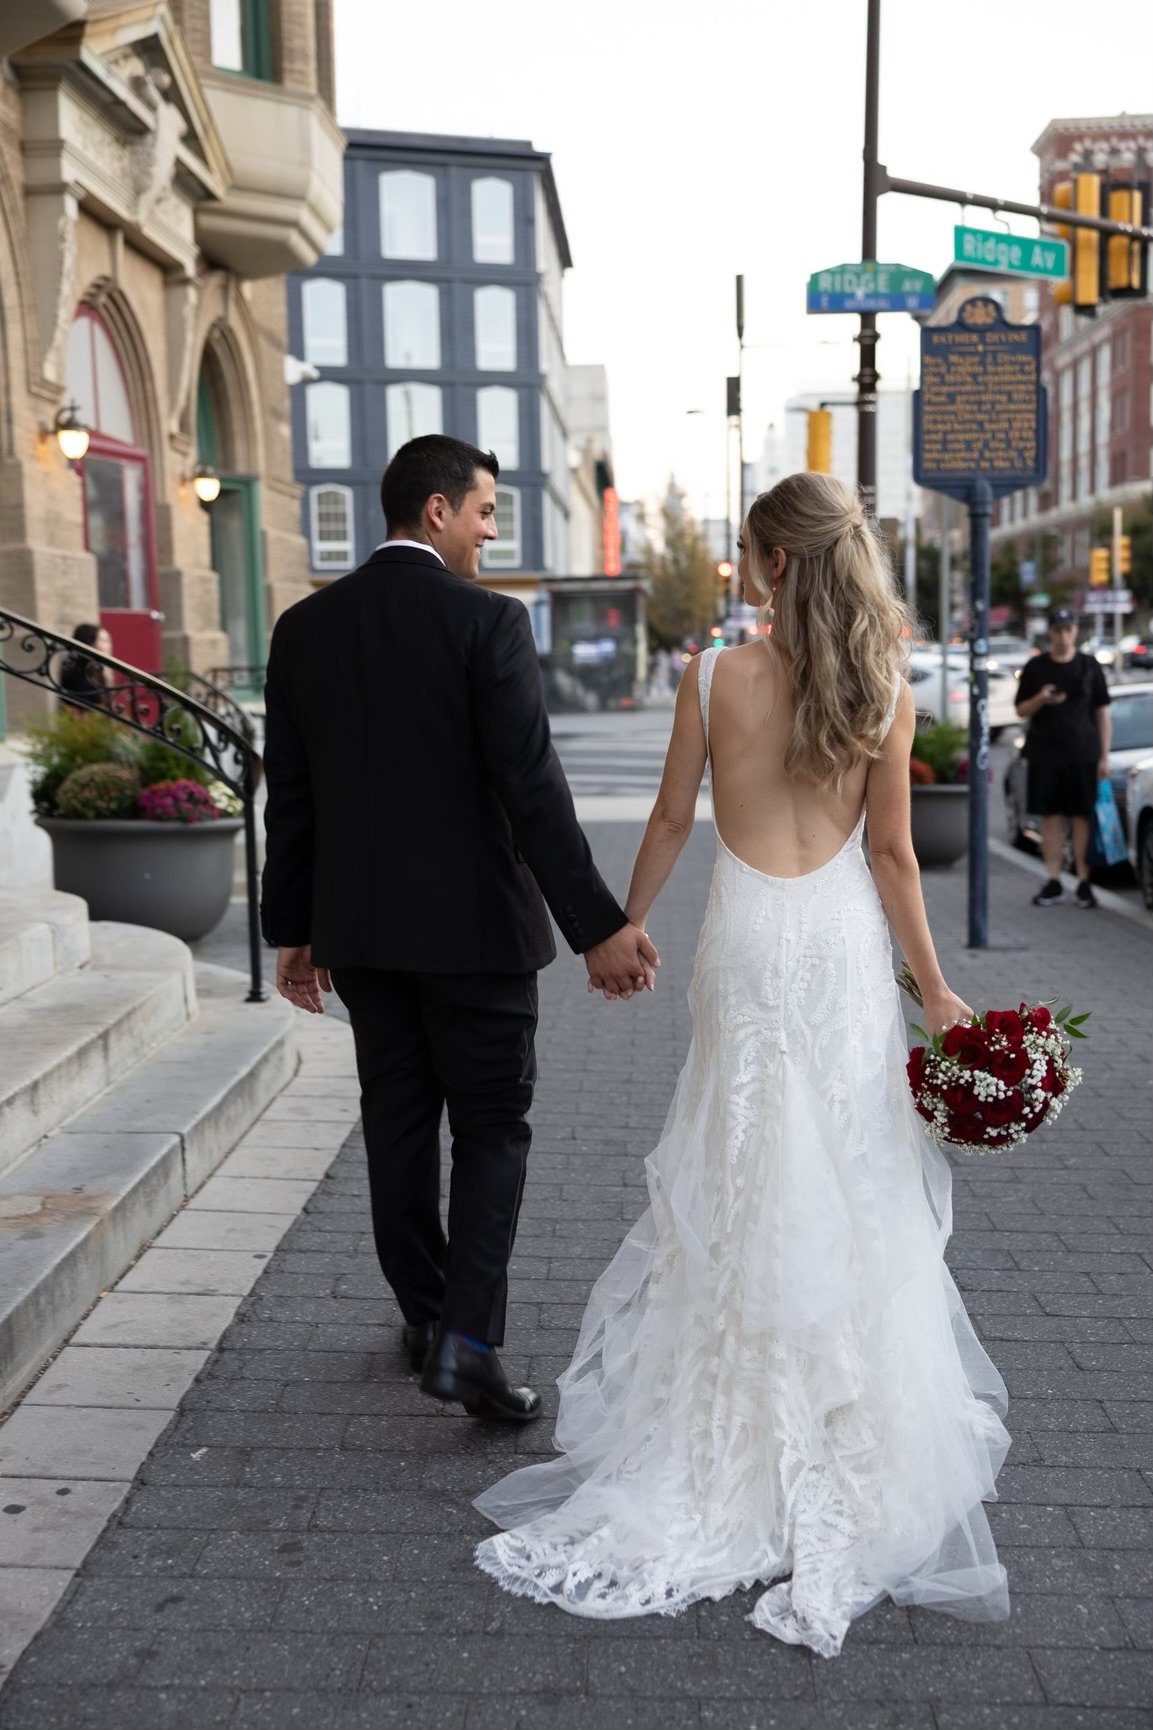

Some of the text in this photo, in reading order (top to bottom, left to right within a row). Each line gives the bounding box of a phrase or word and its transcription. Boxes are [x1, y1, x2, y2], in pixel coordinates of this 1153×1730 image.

[963, 233, 1056, 270] Ridge Av
[818, 273, 924, 293] RIDGE AV
